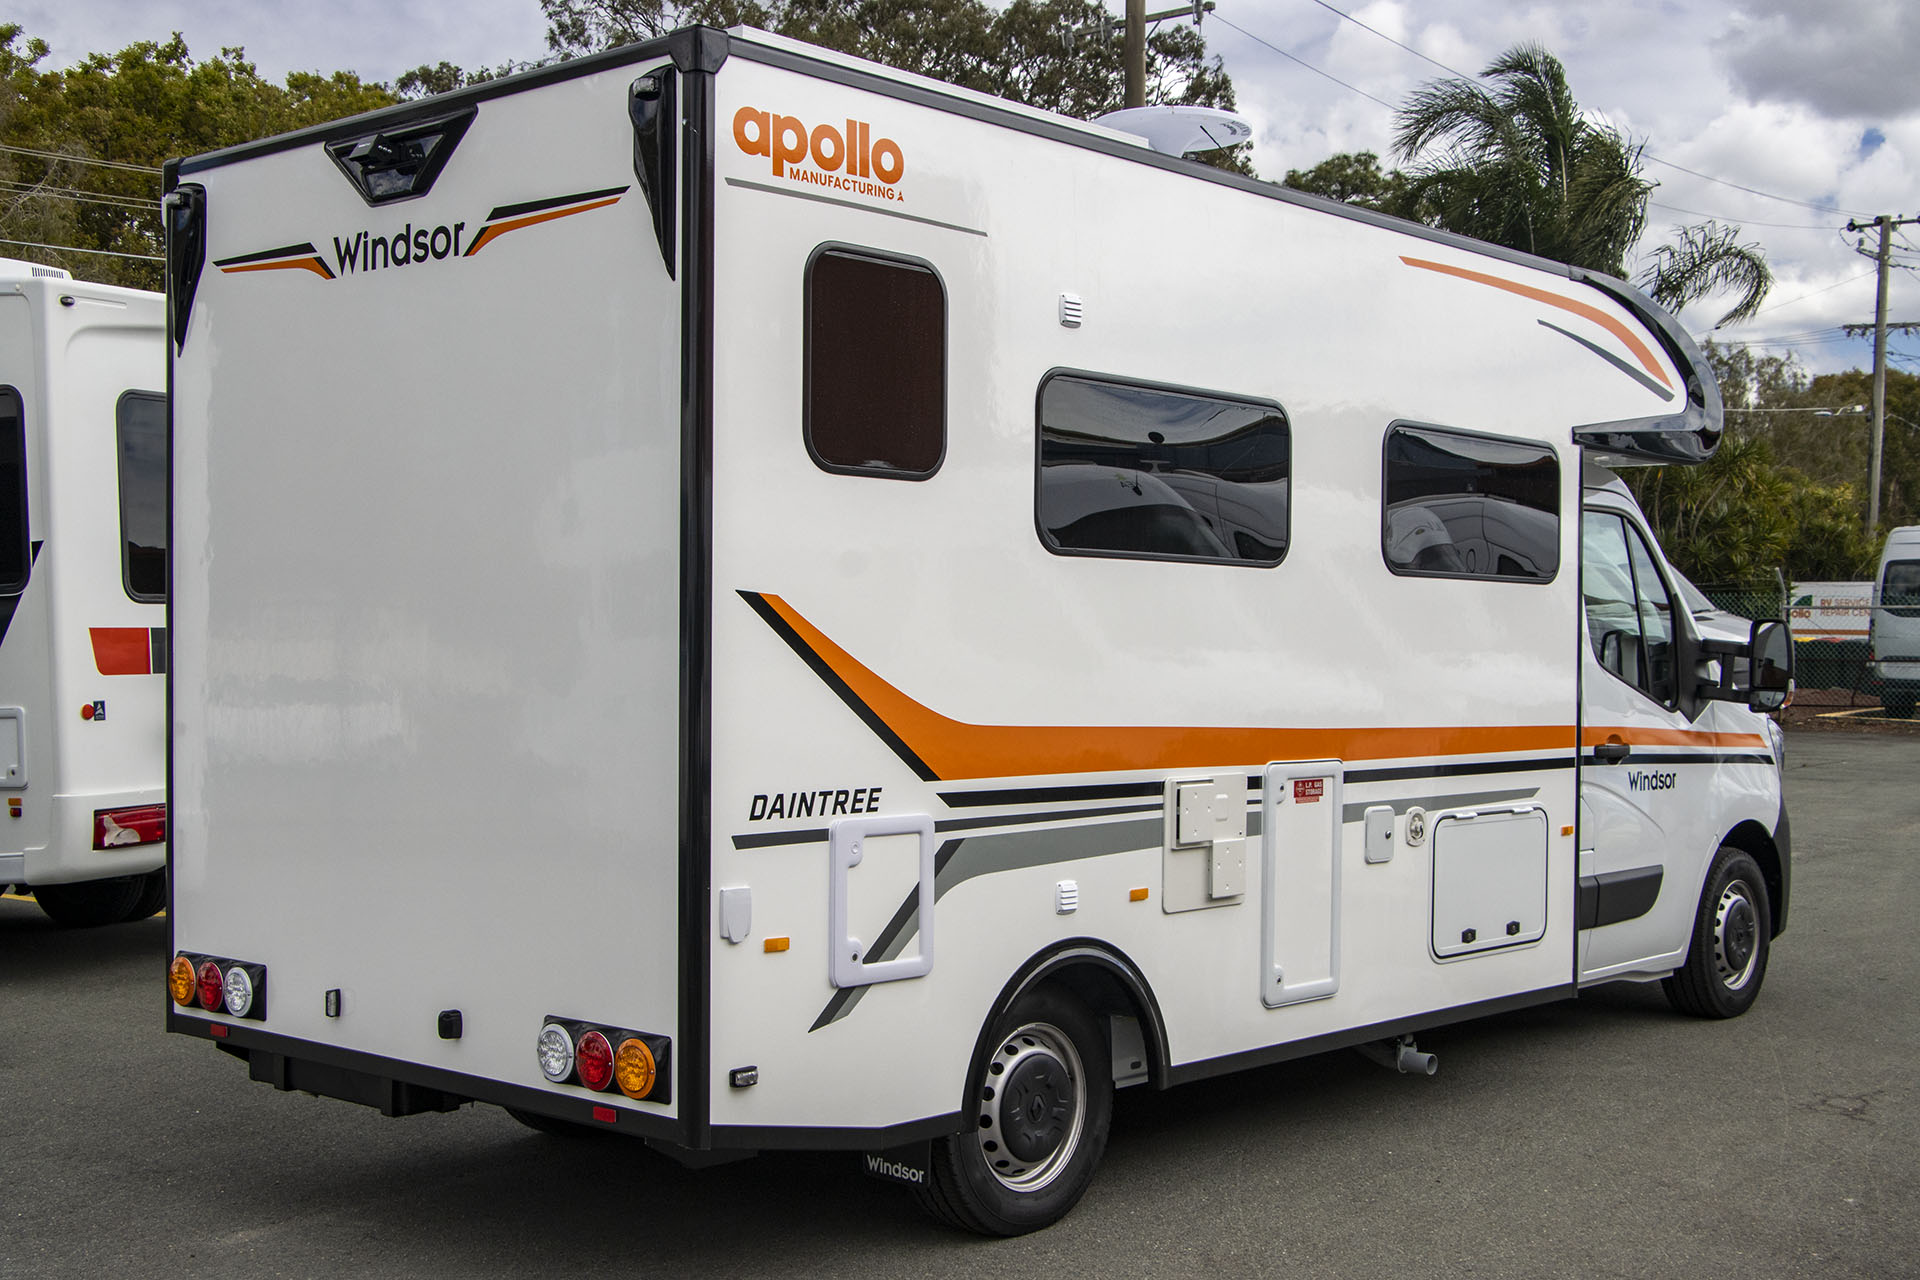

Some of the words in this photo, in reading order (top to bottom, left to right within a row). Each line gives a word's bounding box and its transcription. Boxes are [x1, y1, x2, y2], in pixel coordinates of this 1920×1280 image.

[732, 105, 904, 184] apollo
[789, 166, 895, 200] MANUFACTURING
[332, 221, 466, 277] Windsor
[1820, 598, 1833, 607] RV
[1628, 770, 1676, 791] Windsor
[749, 787, 882, 821] DAINTREE
[866, 1154, 925, 1183] Windsor
